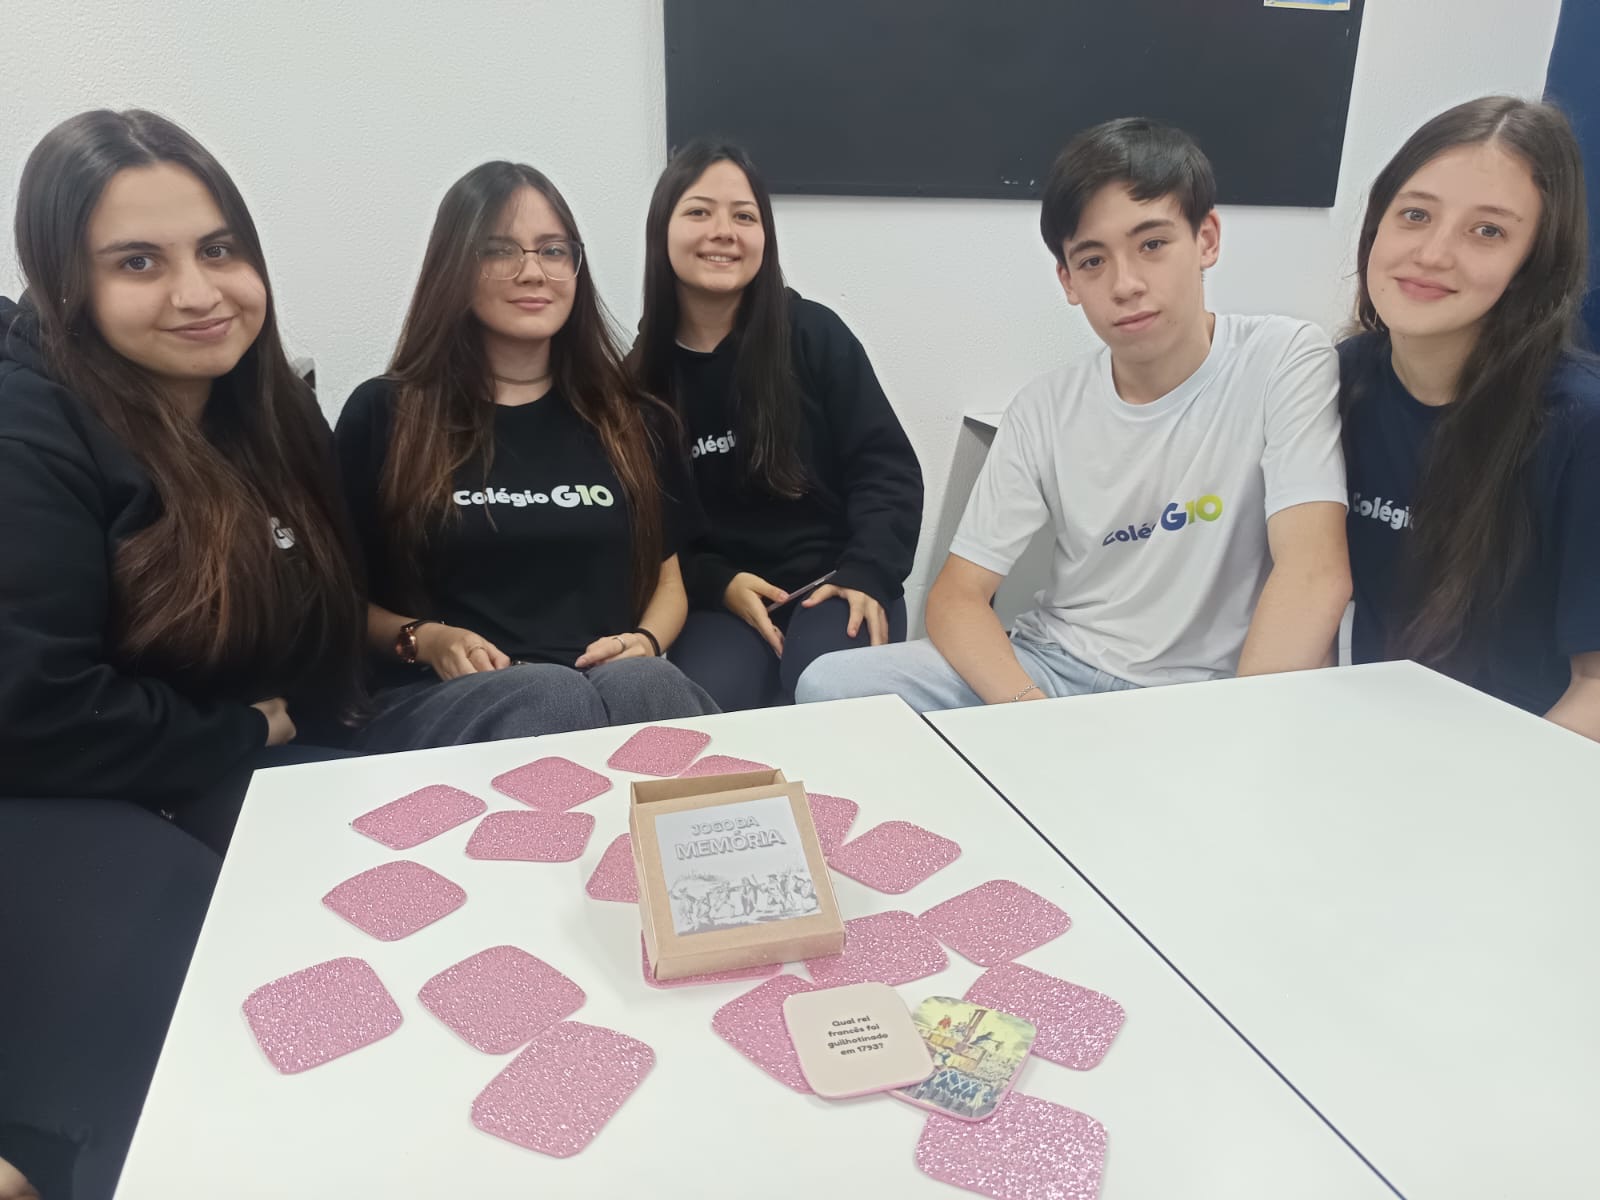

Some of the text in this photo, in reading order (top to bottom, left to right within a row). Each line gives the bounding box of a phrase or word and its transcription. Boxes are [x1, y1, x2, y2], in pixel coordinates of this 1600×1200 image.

[691, 430, 737, 458] olégi
[453, 485, 614, 508] Colégio G10
[1160, 494, 1223, 532] G10
[1353, 492, 1413, 530] Colégi
[690, 816, 760, 836] JOGO DA
[674, 829, 787, 860] MEMÓRIA
[832, 1015, 871, 1027] Qual rei
[828, 1027, 865, 1037] francês
[828, 1033, 889, 1049] guilhotinado
[857, 1042, 884, 1053] 1793?
